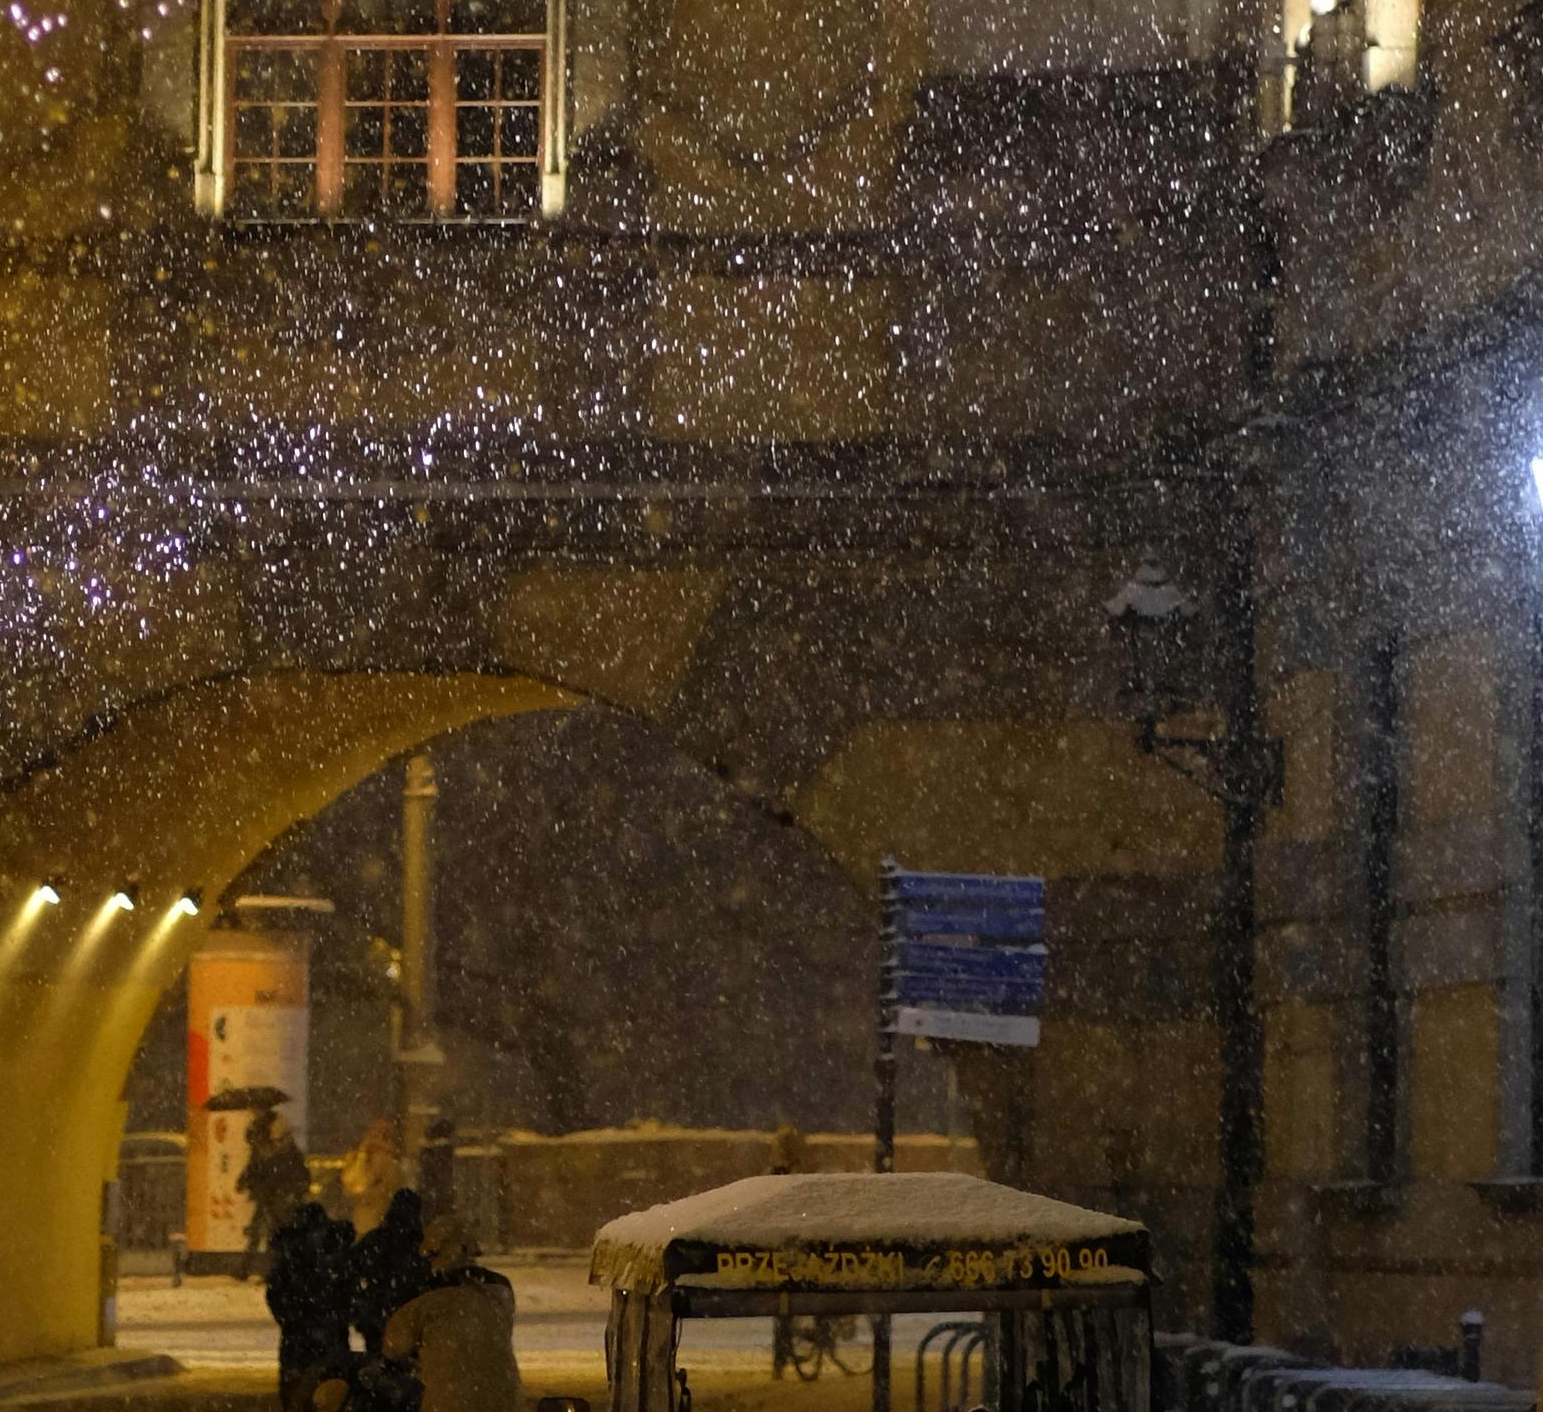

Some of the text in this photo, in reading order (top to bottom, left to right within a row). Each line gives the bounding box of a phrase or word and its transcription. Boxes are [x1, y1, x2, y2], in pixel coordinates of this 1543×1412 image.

[951, 1249, 996, 1282] 666
[1002, 1249, 1033, 1280] 73
[1040, 1246, 1072, 1279] 90
